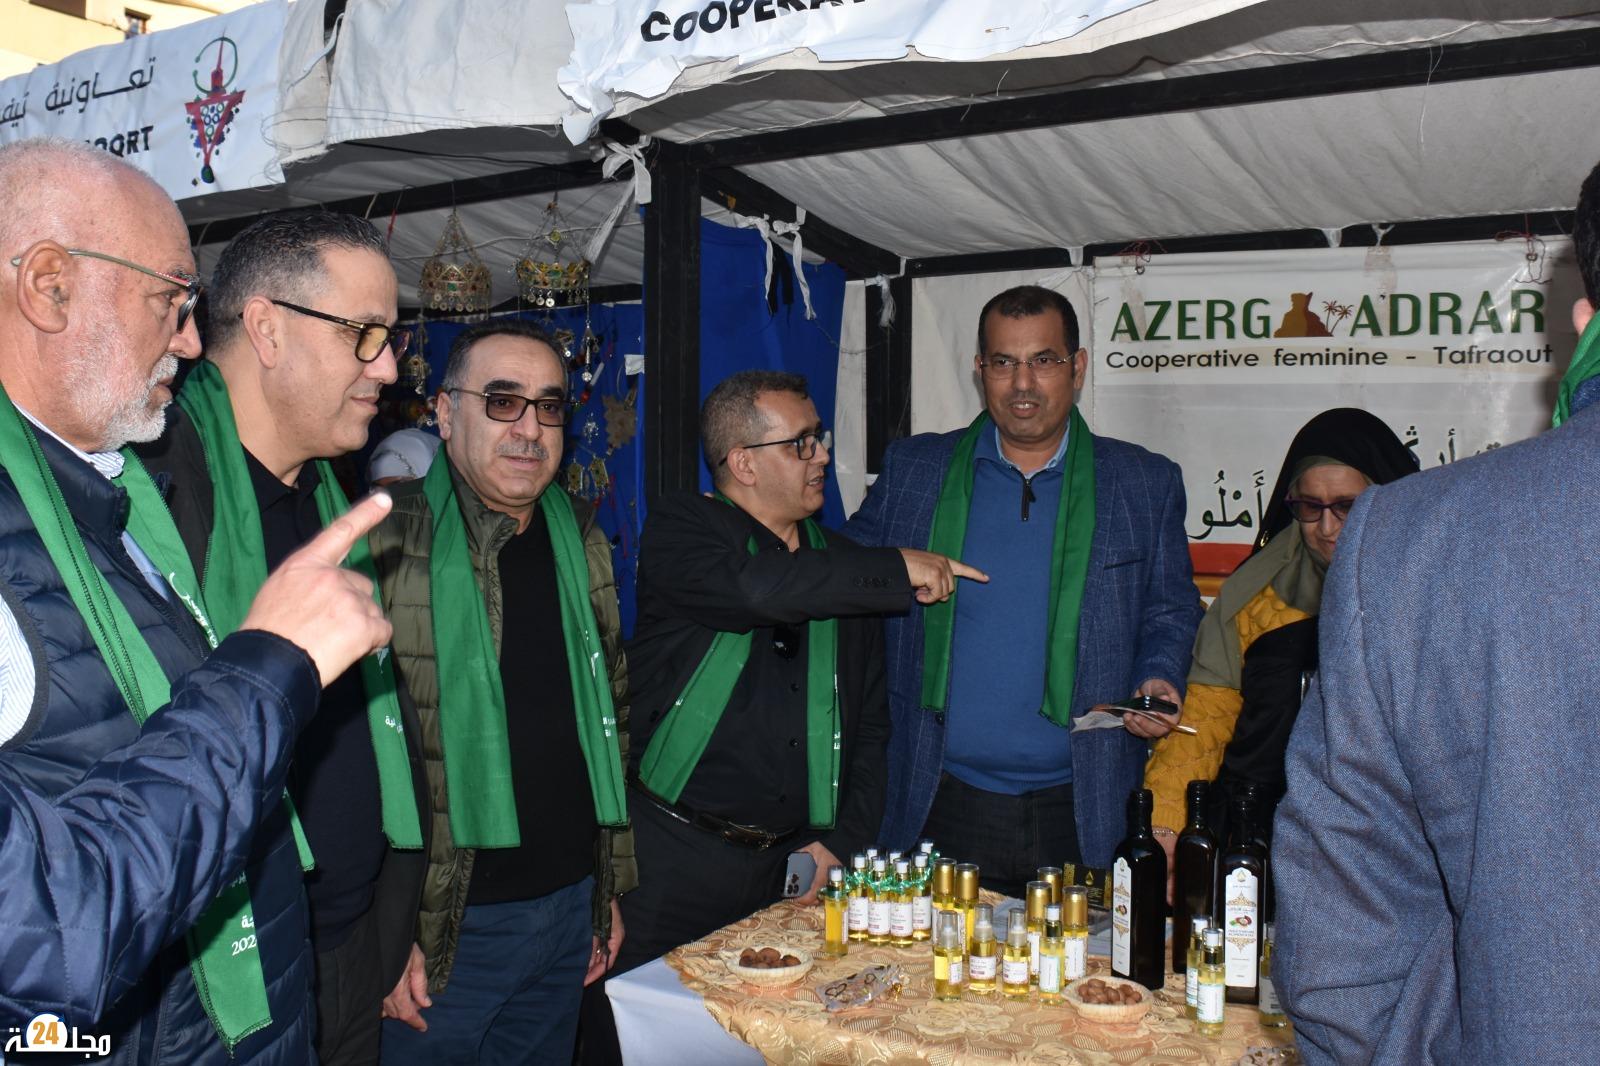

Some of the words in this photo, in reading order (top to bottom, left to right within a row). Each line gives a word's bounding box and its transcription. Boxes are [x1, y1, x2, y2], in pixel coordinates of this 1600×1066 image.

[1110, 298, 1271, 342] AZERG
[1349, 289, 1545, 337] ADRAR
[1106, 349, 1260, 373] Cooperative
[1274, 347, 1388, 367] feminine
[1433, 344, 1554, 365] Tafraout
[231, 934, 258, 956] 202
